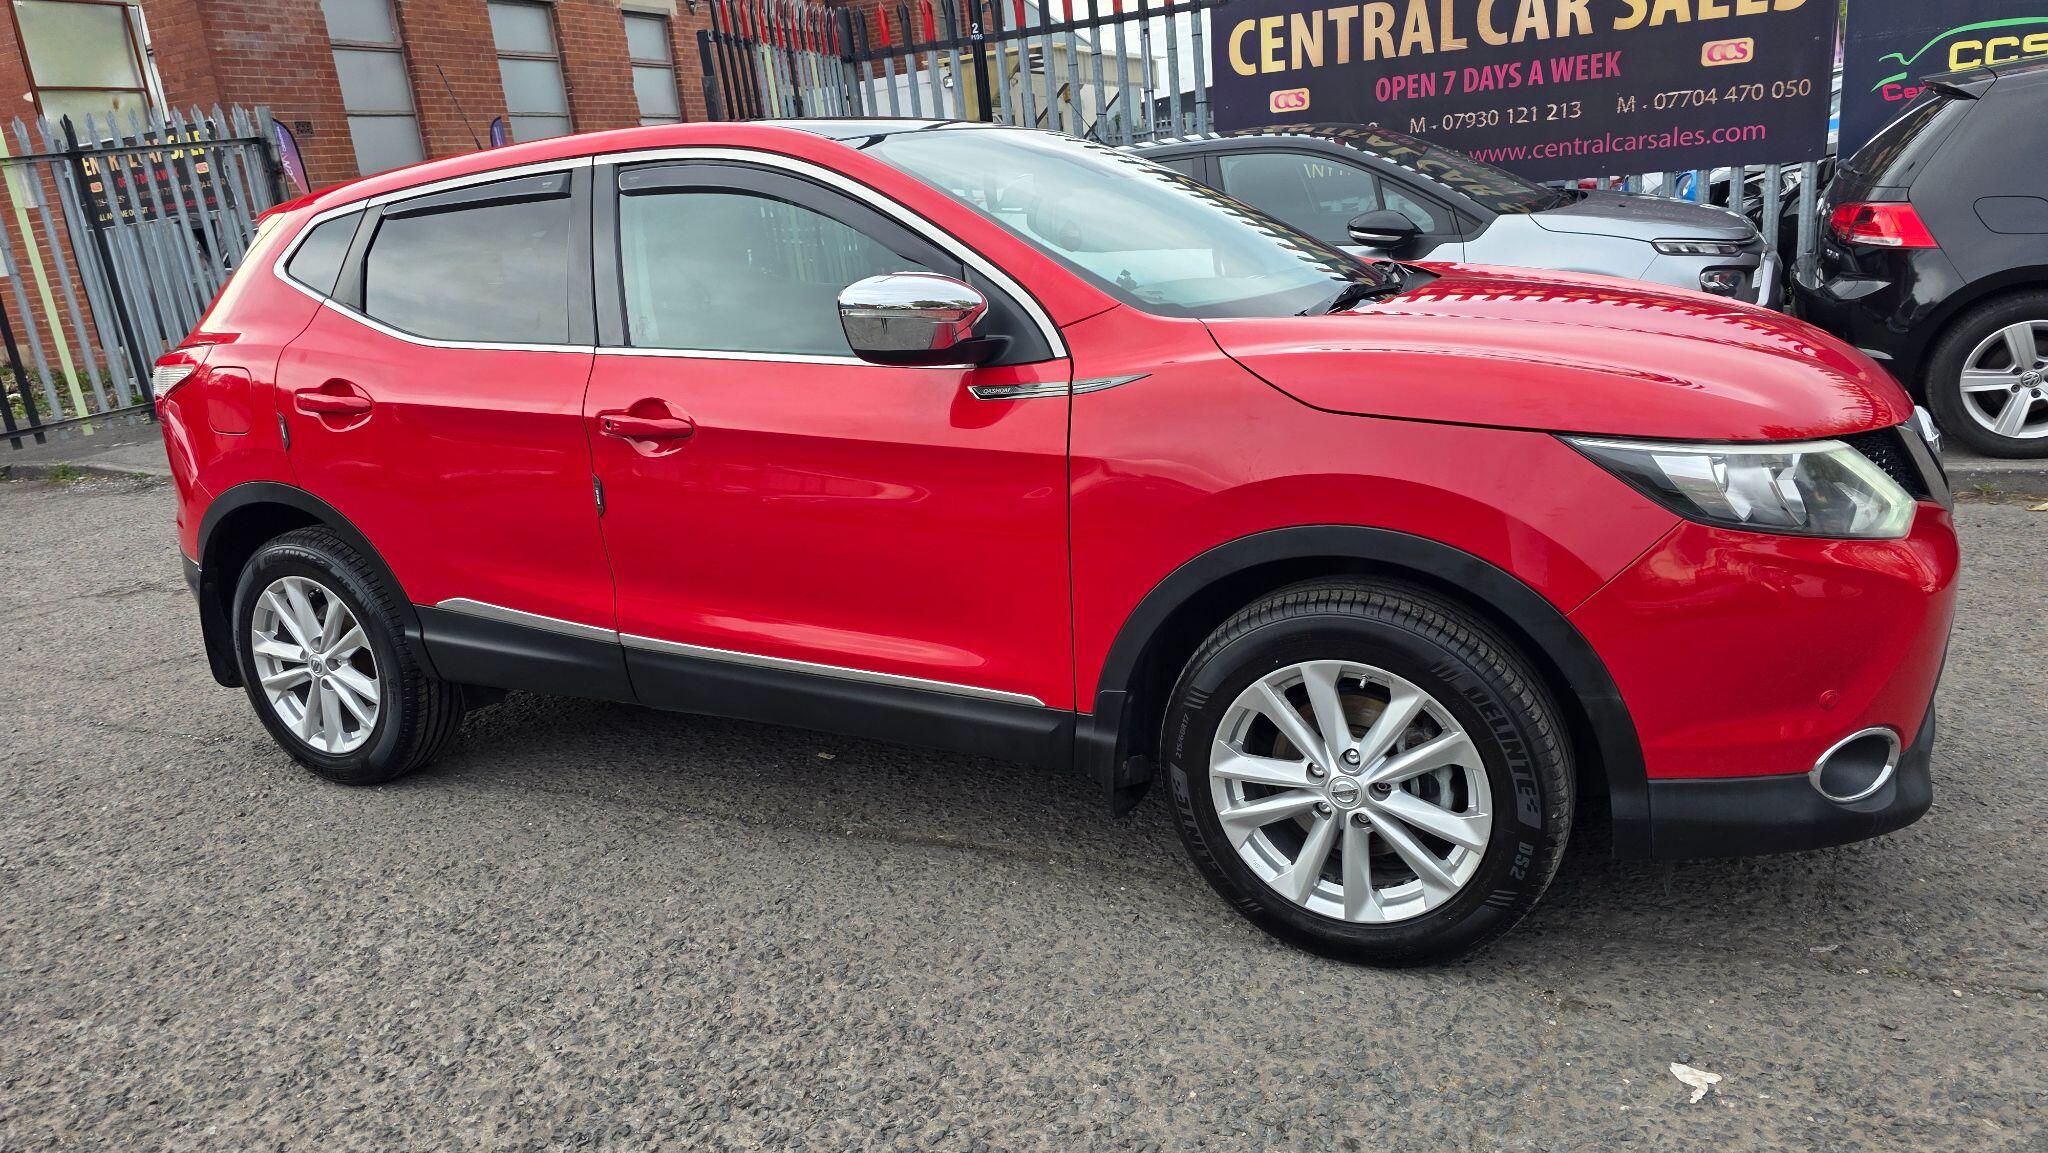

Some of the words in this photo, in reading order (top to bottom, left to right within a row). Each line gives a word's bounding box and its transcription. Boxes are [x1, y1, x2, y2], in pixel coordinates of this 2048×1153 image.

[971, 23, 979, 34] 2
[1228, 0, 1469, 76] CENTRAL
[1476, 0, 1594, 46] CAR
[1707, 41, 1748, 63] CCS
[1375, 72, 1436, 102] OPEN
[1442, 70, 1457, 95] 7
[1463, 61, 1522, 93] DAYS
[1527, 59, 1544, 86] A
[1550, 50, 1623, 84] WEEK
[1274, 91, 1306, 110] CCS
[1653, 87, 1718, 110] 07704
[1723, 83, 1764, 103] 470
[1771, 78, 1812, 99] 050
[1442, 109, 1499, 131] 07930
[1507, 105, 1538, 124] 121
[1546, 100, 1583, 121] 213
[1468, 124, 1766, 162] www.centralcarsales.com
[1464, 687, 1534, 795] DELINTE
[1509, 841, 1534, 881] DS2
